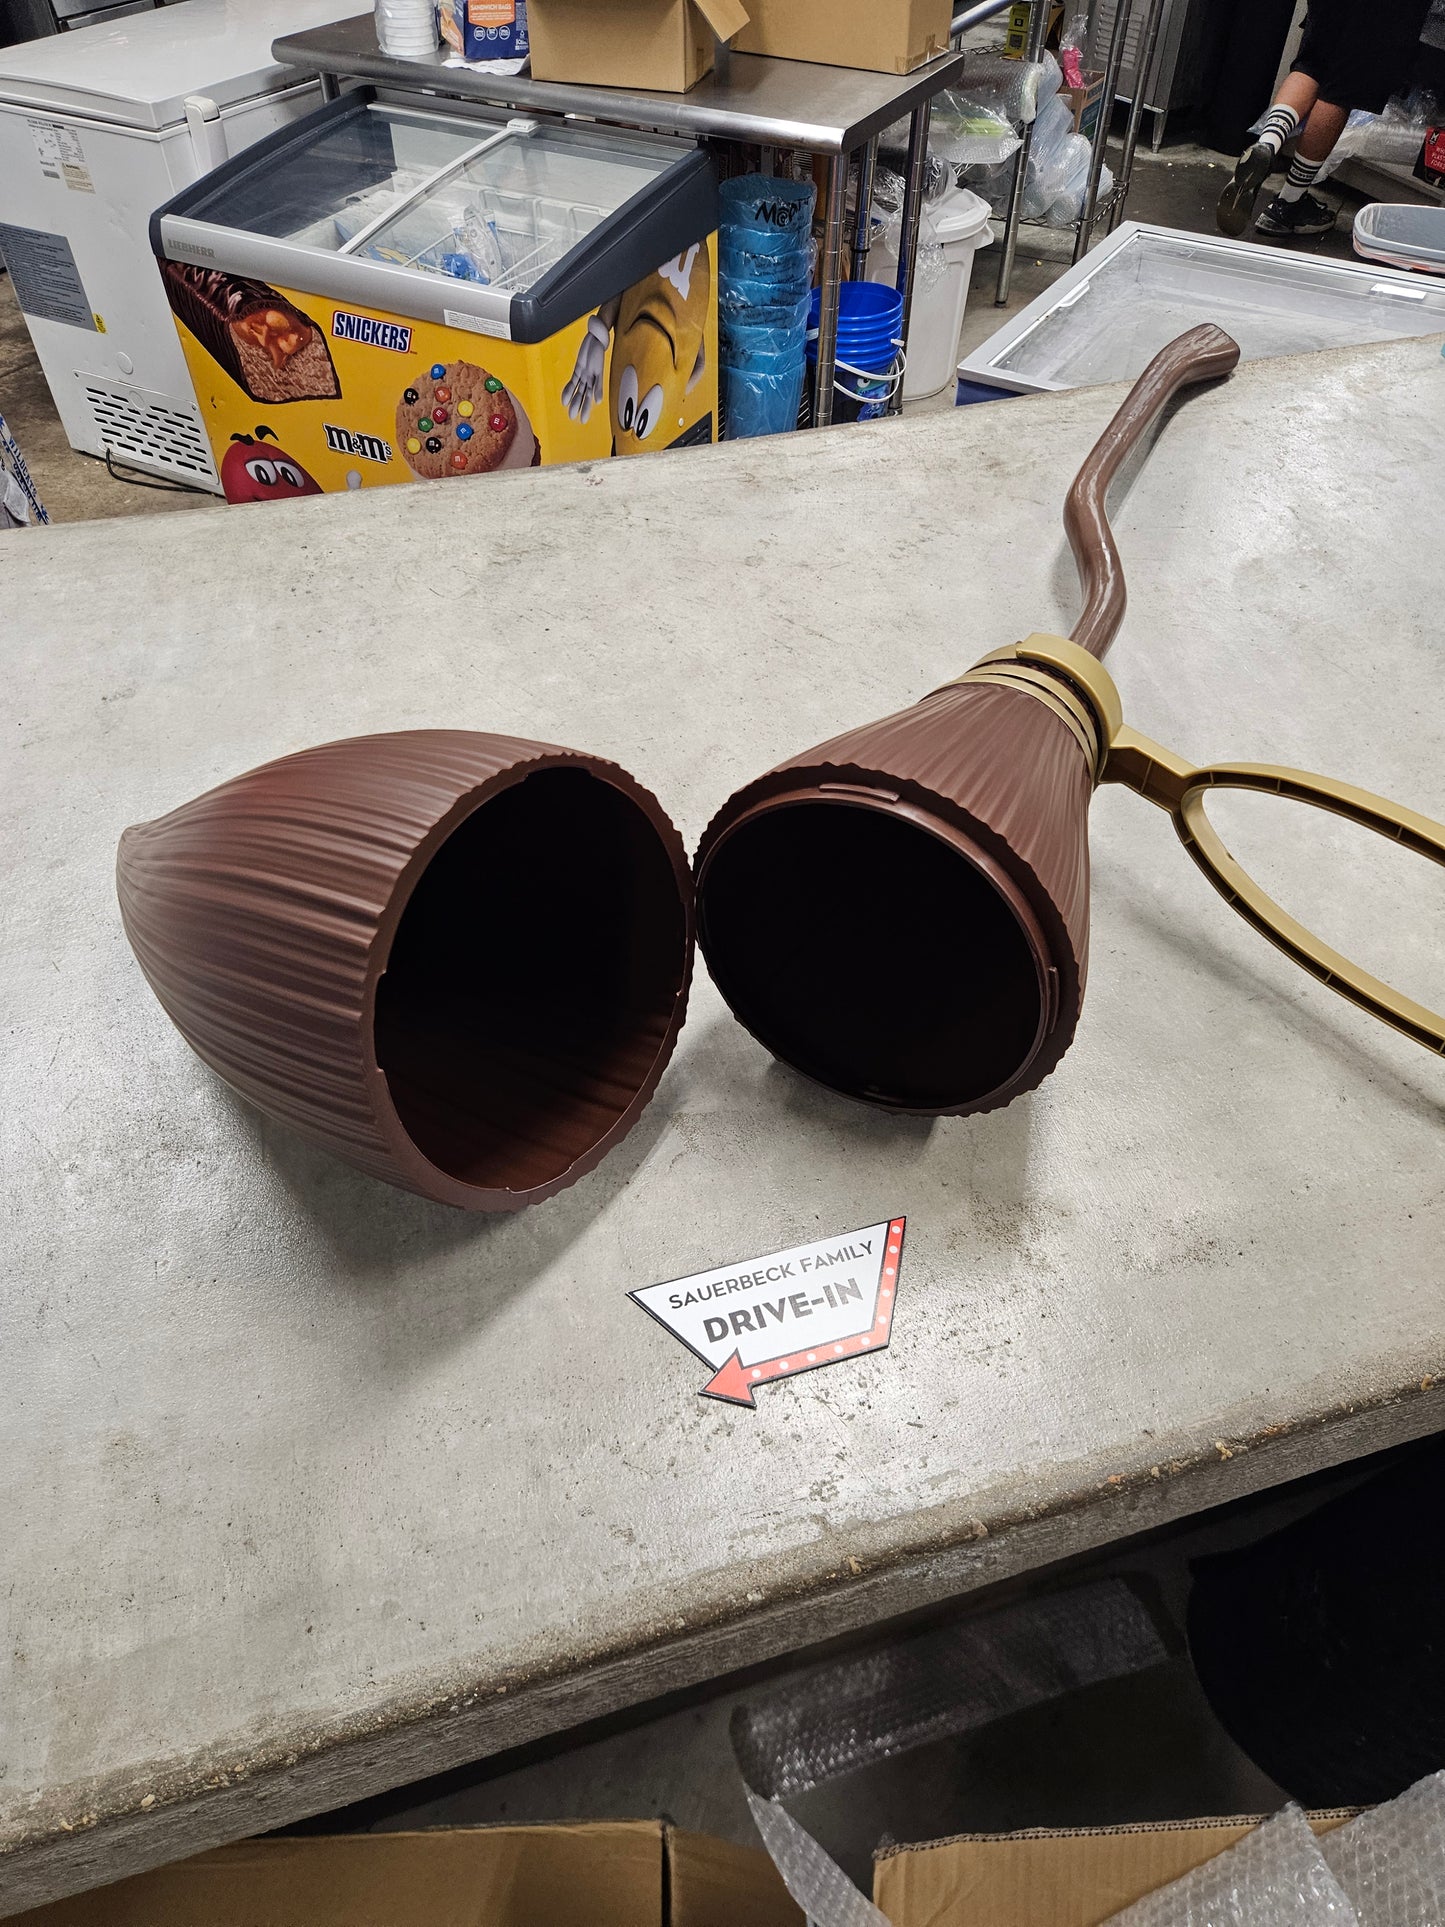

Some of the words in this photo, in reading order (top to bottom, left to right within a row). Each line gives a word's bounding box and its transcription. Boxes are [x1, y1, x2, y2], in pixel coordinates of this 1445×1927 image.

[335, 312, 409, 351] SNICKERS
[669, 1262, 795, 1309] SAUERBECK
[799, 1240, 874, 1273] FAMILY
[702, 1277, 864, 1343] DRIVE-IN
